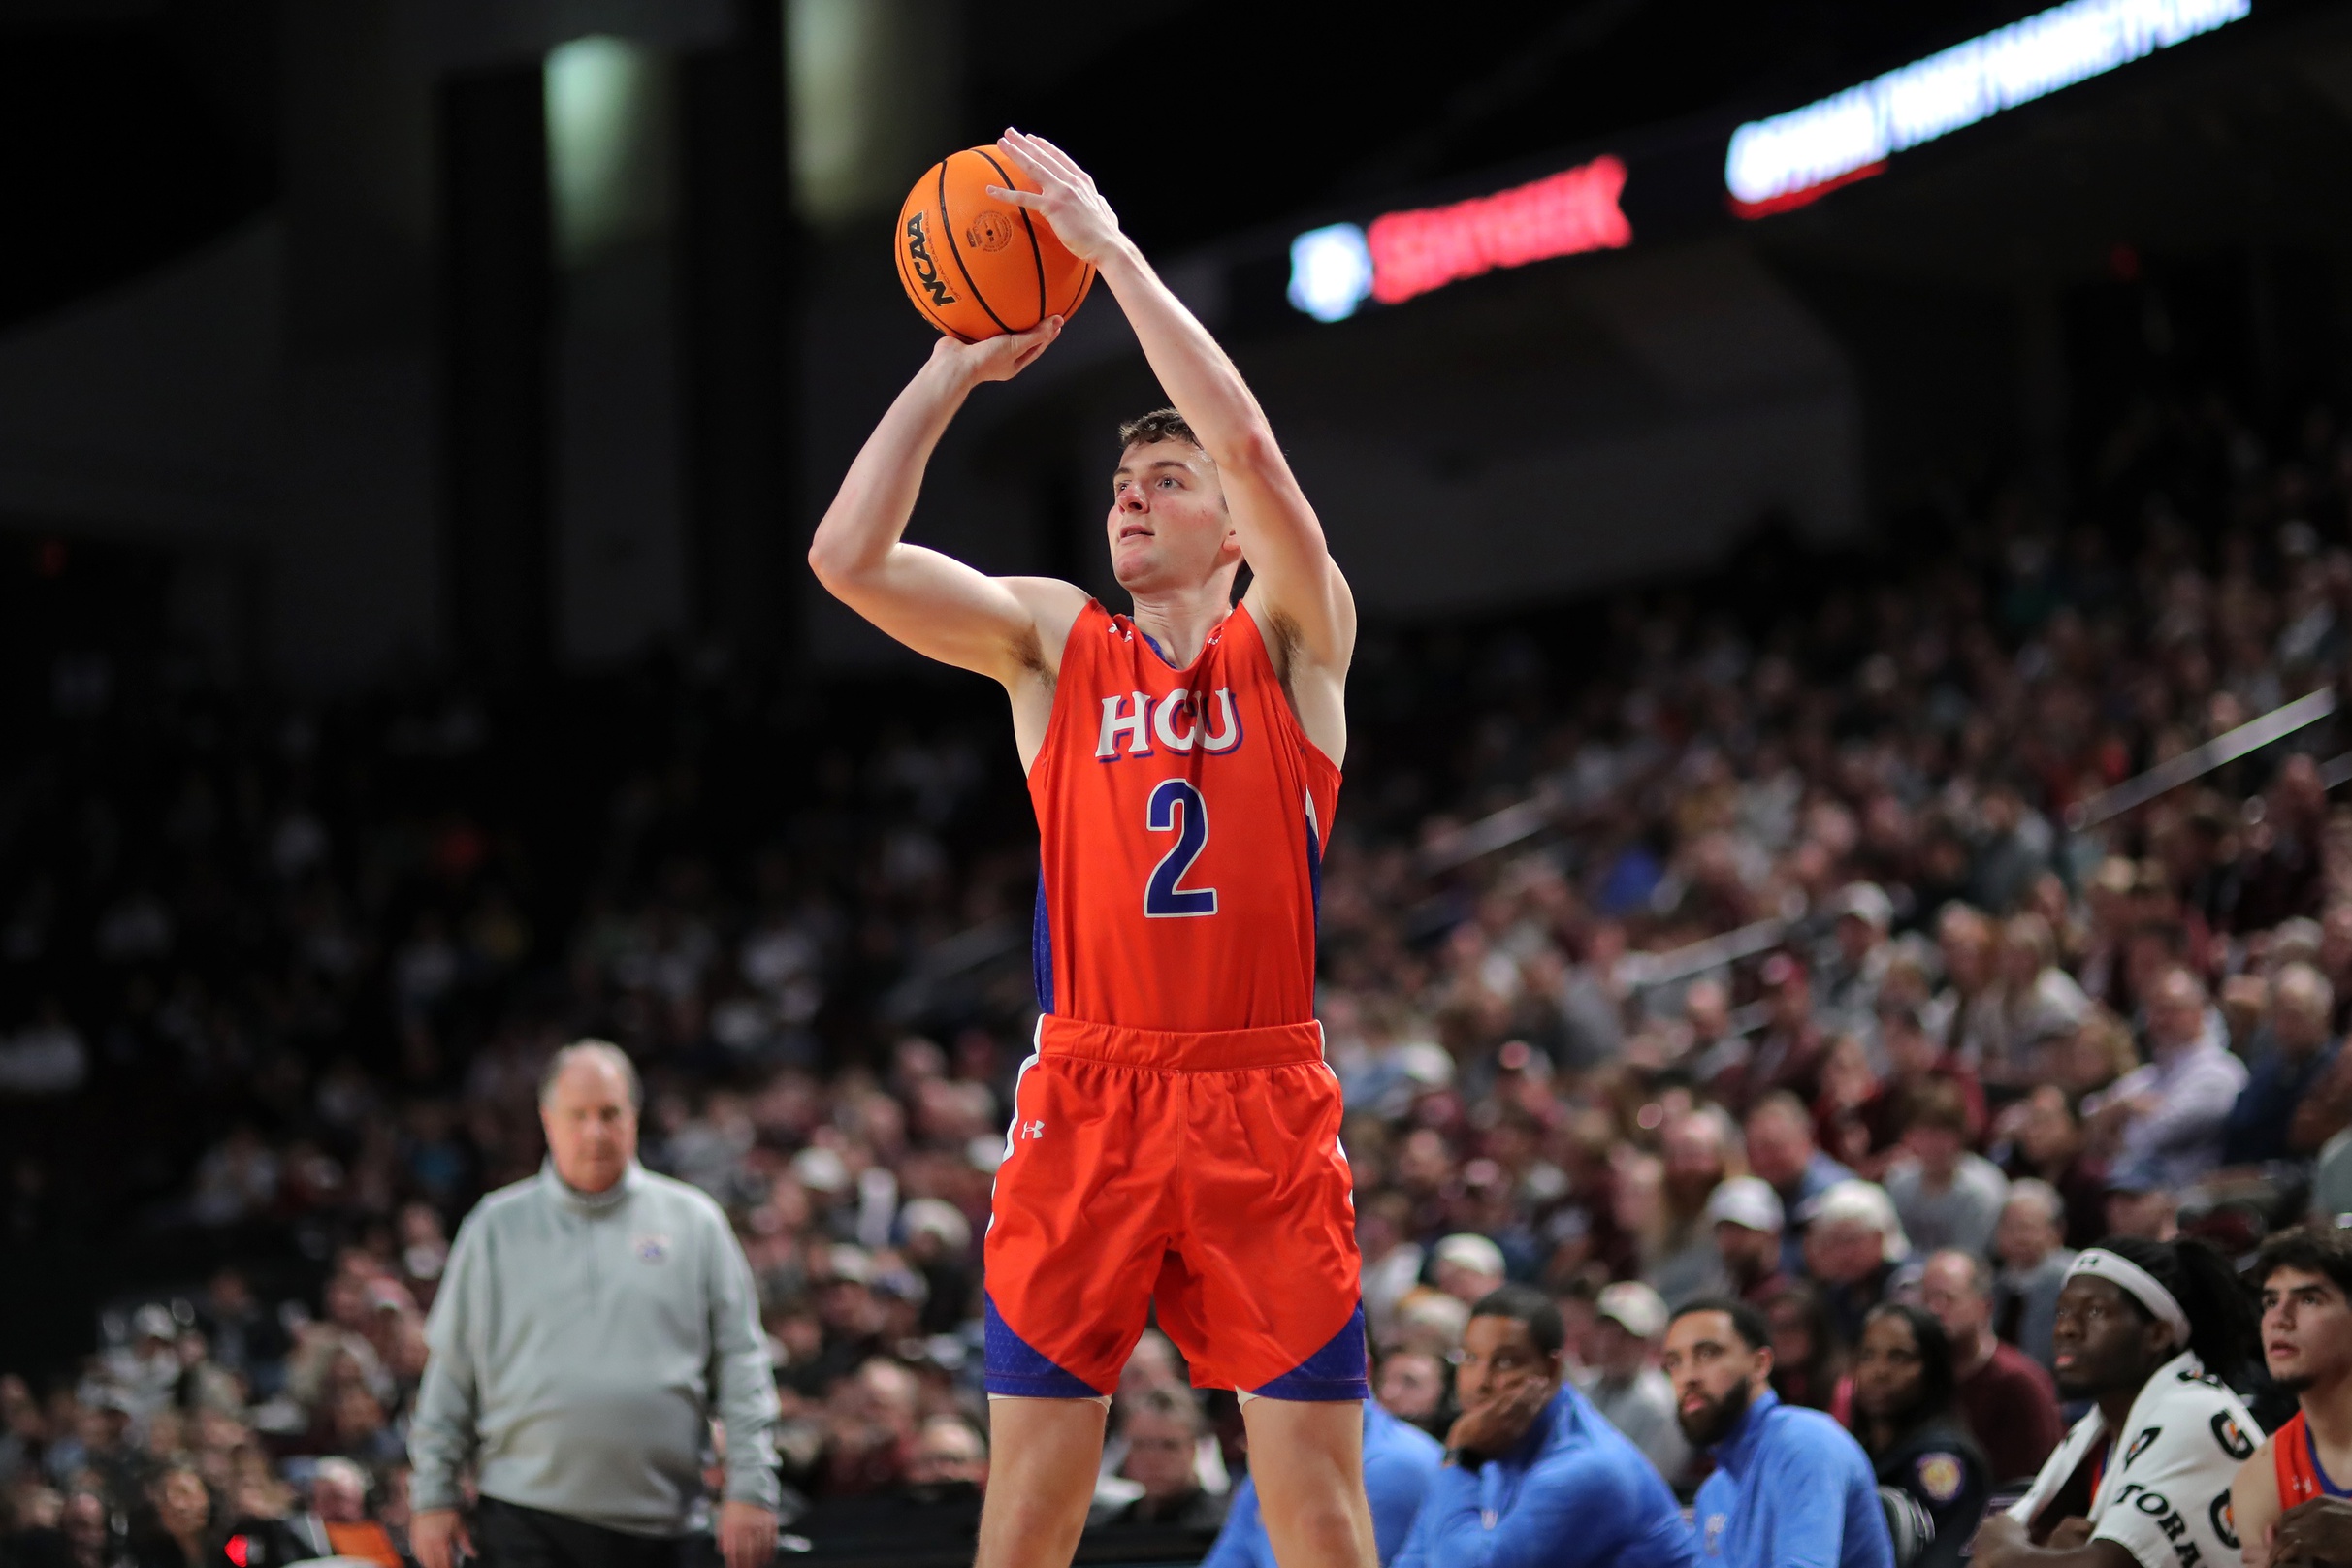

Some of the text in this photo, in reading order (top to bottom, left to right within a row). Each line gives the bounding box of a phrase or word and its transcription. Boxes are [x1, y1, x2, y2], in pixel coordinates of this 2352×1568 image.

[907, 210, 956, 307] NCAA
[1095, 687, 1243, 763] HCU
[1144, 778, 1218, 918] 2
[2114, 1484, 2208, 1568] TORA
